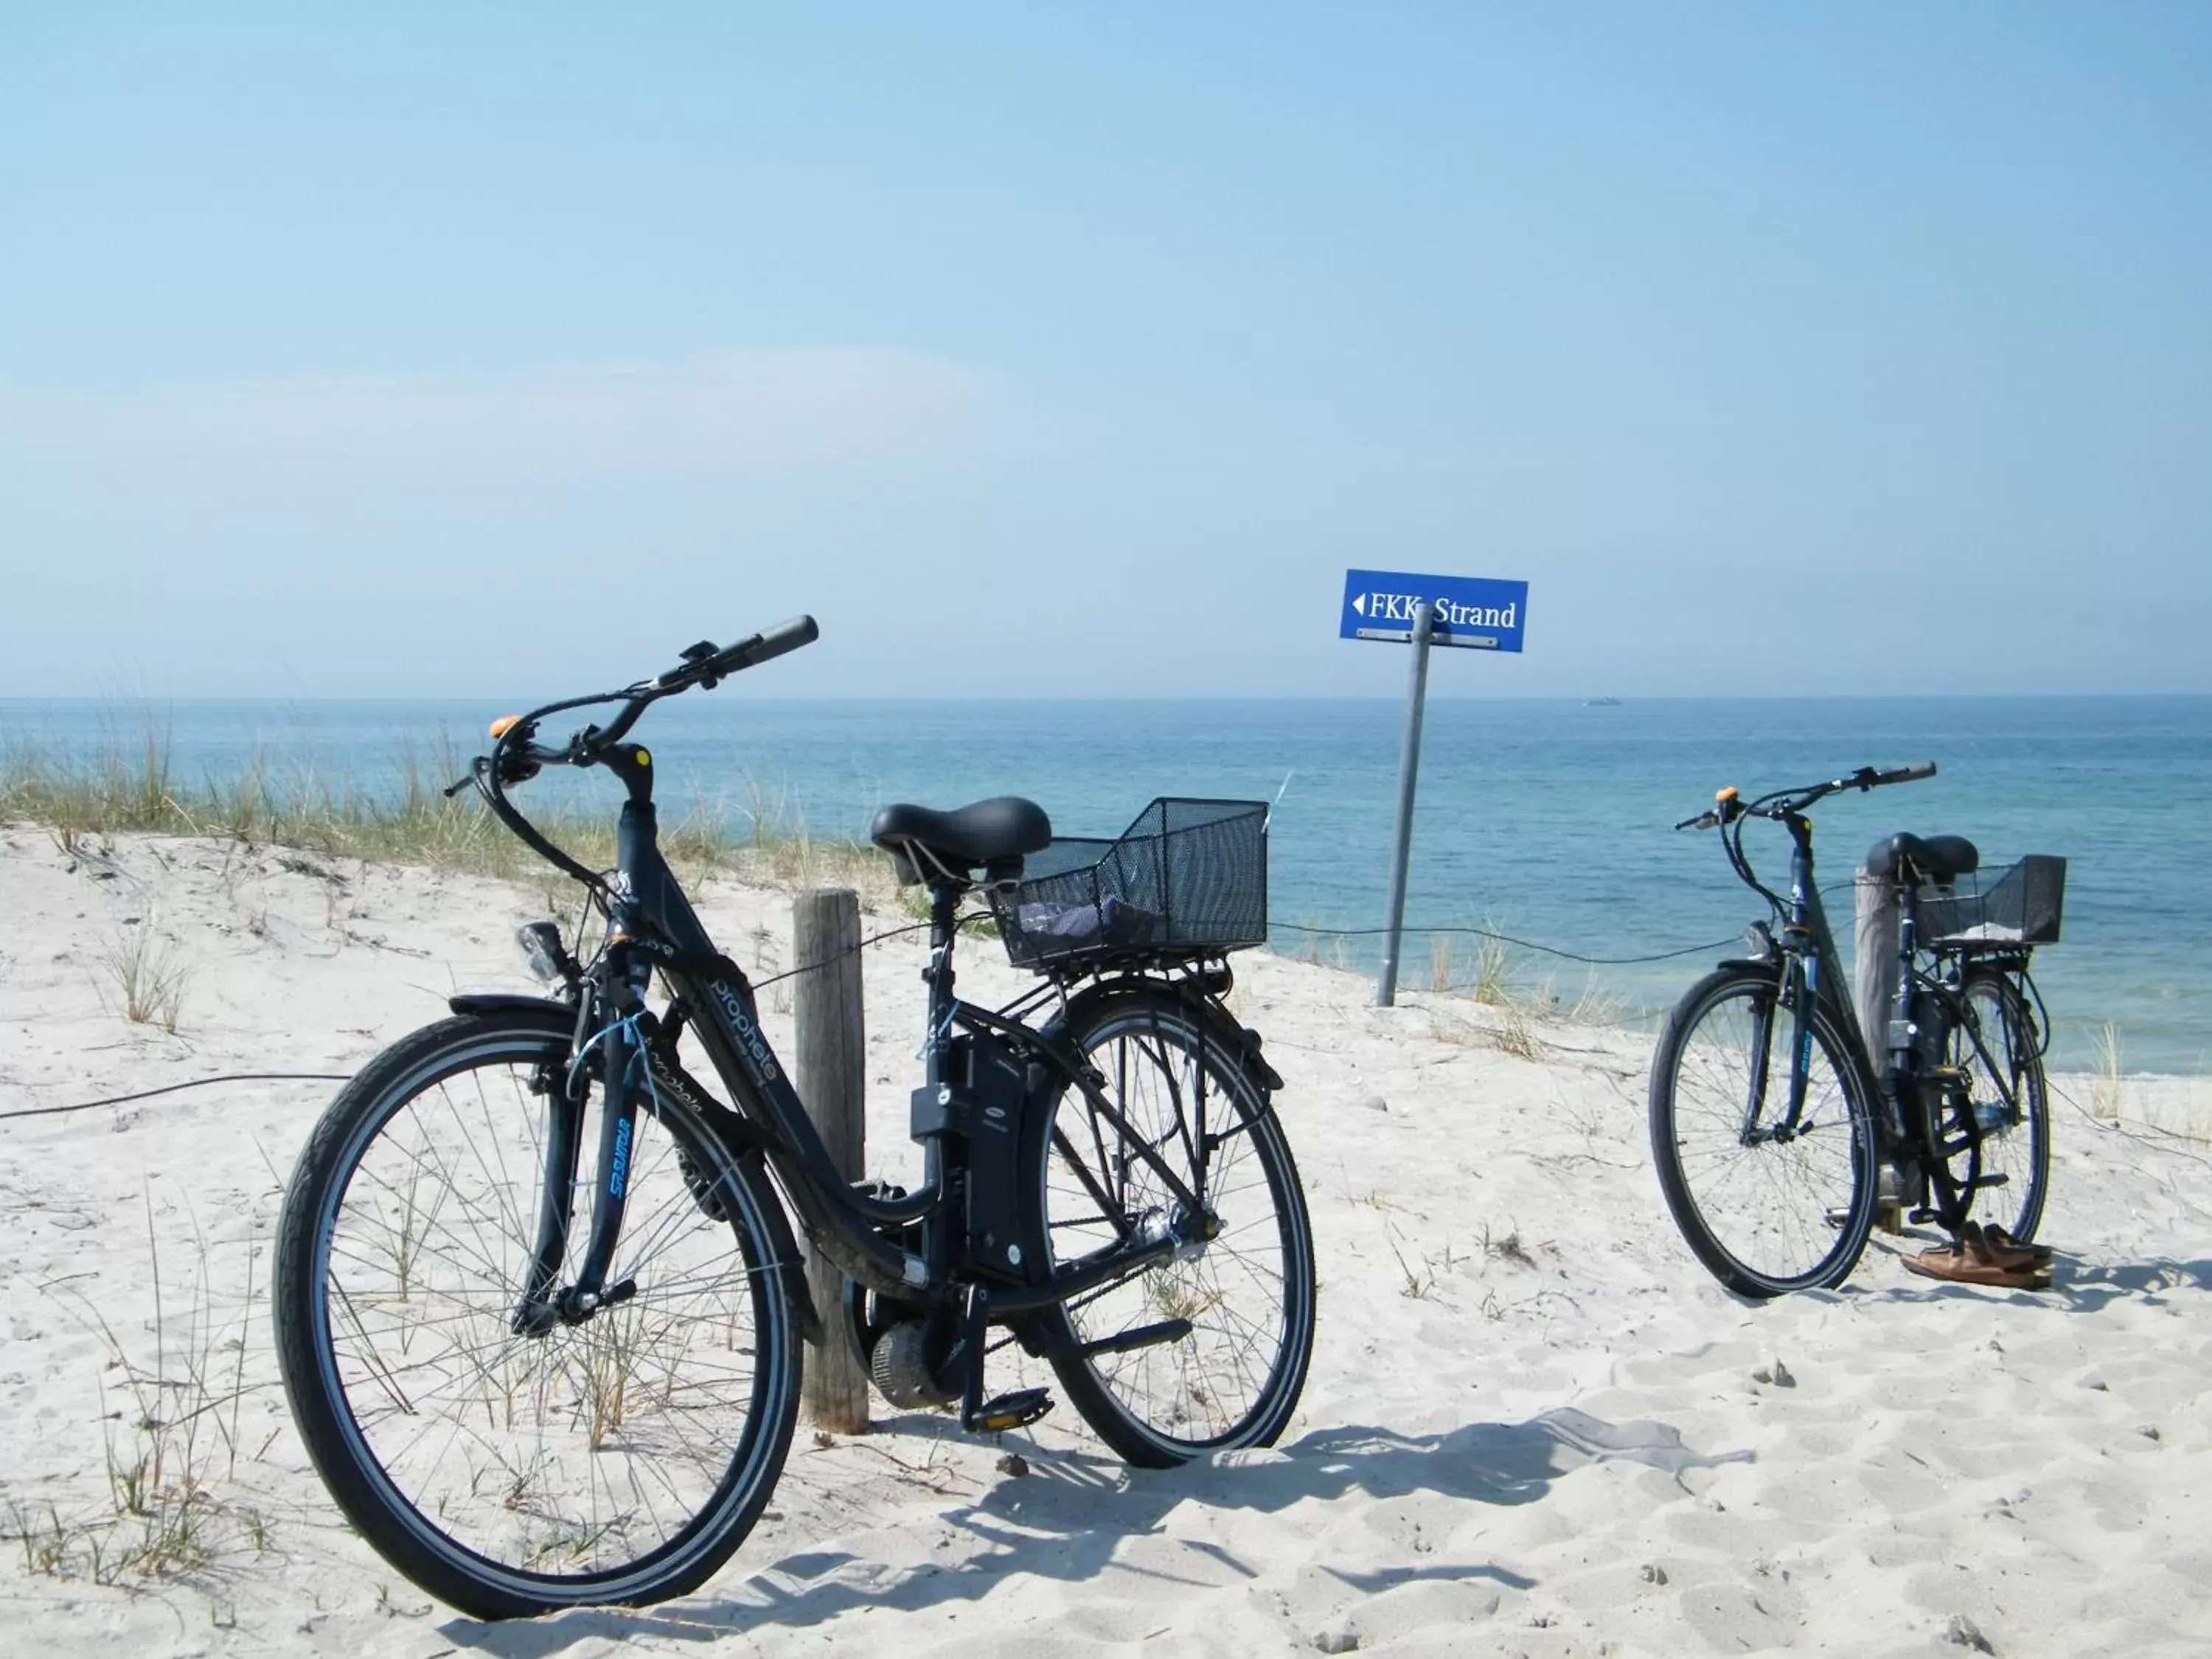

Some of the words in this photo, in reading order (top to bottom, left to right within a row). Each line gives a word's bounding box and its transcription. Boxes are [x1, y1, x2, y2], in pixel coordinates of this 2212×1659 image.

[1368, 592, 1422, 621] FKK
[1434, 598, 1516, 627] Strand
[711, 978, 776, 1080] prophete
